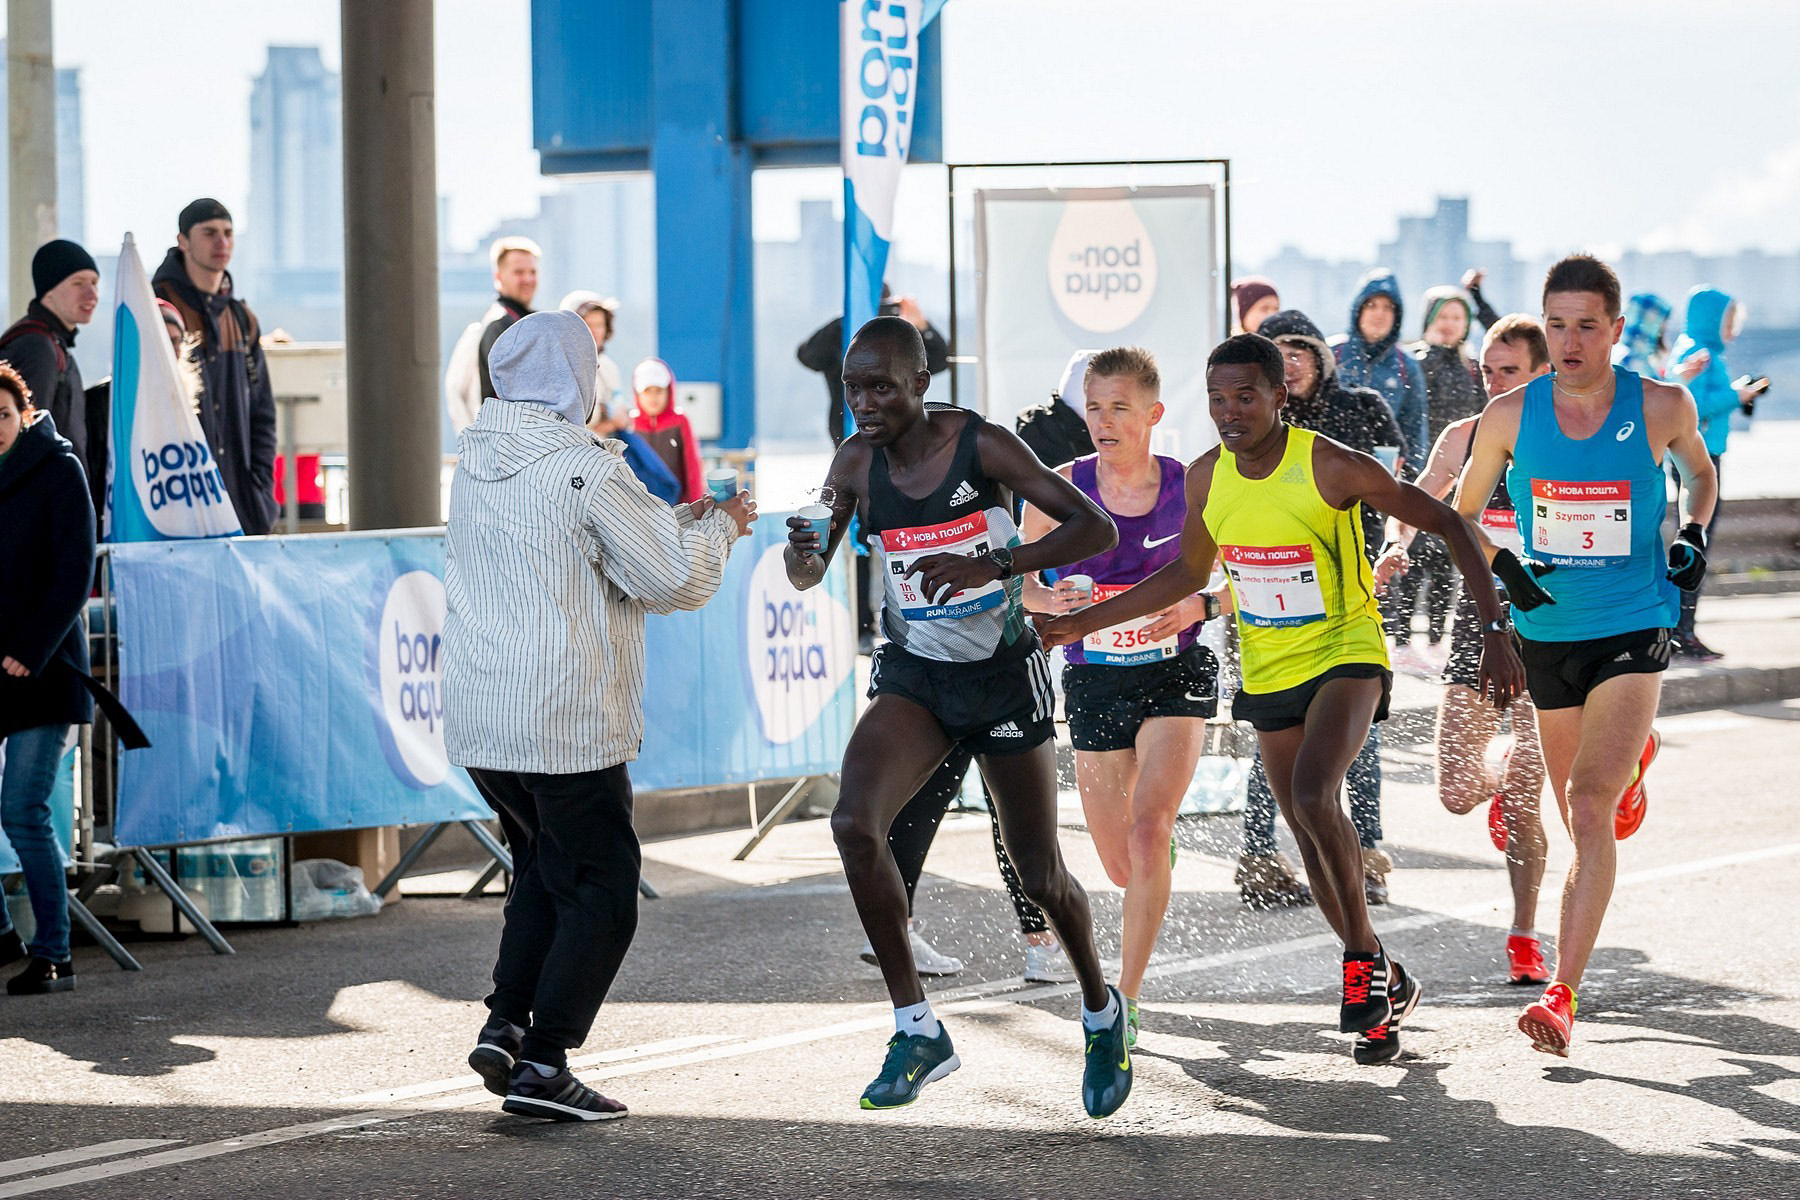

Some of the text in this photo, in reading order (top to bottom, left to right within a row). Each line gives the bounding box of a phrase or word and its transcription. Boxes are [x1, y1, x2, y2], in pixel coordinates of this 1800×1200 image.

[1558, 486, 1619, 495] НОВА ПОШТА
[949, 490, 979, 507] adidas
[1555, 512, 1596, 522] Szymon
[912, 521, 975, 542] НОВА ПОШТА
[1538, 537, 1549, 546] 30
[1582, 531, 1594, 550] 3
[1243, 551, 1301, 560] НОВА ПОШТА
[900, 583, 912, 592] 1h
[903, 593, 917, 602] 30
[1275, 593, 1285, 611] 1
[926, 608, 945, 618] RUN
[1090, 637, 1102, 645] 30
[1164, 647, 1172, 655] B
[401, 681, 444, 734] aqu
[990, 730, 1024, 738] adidas
